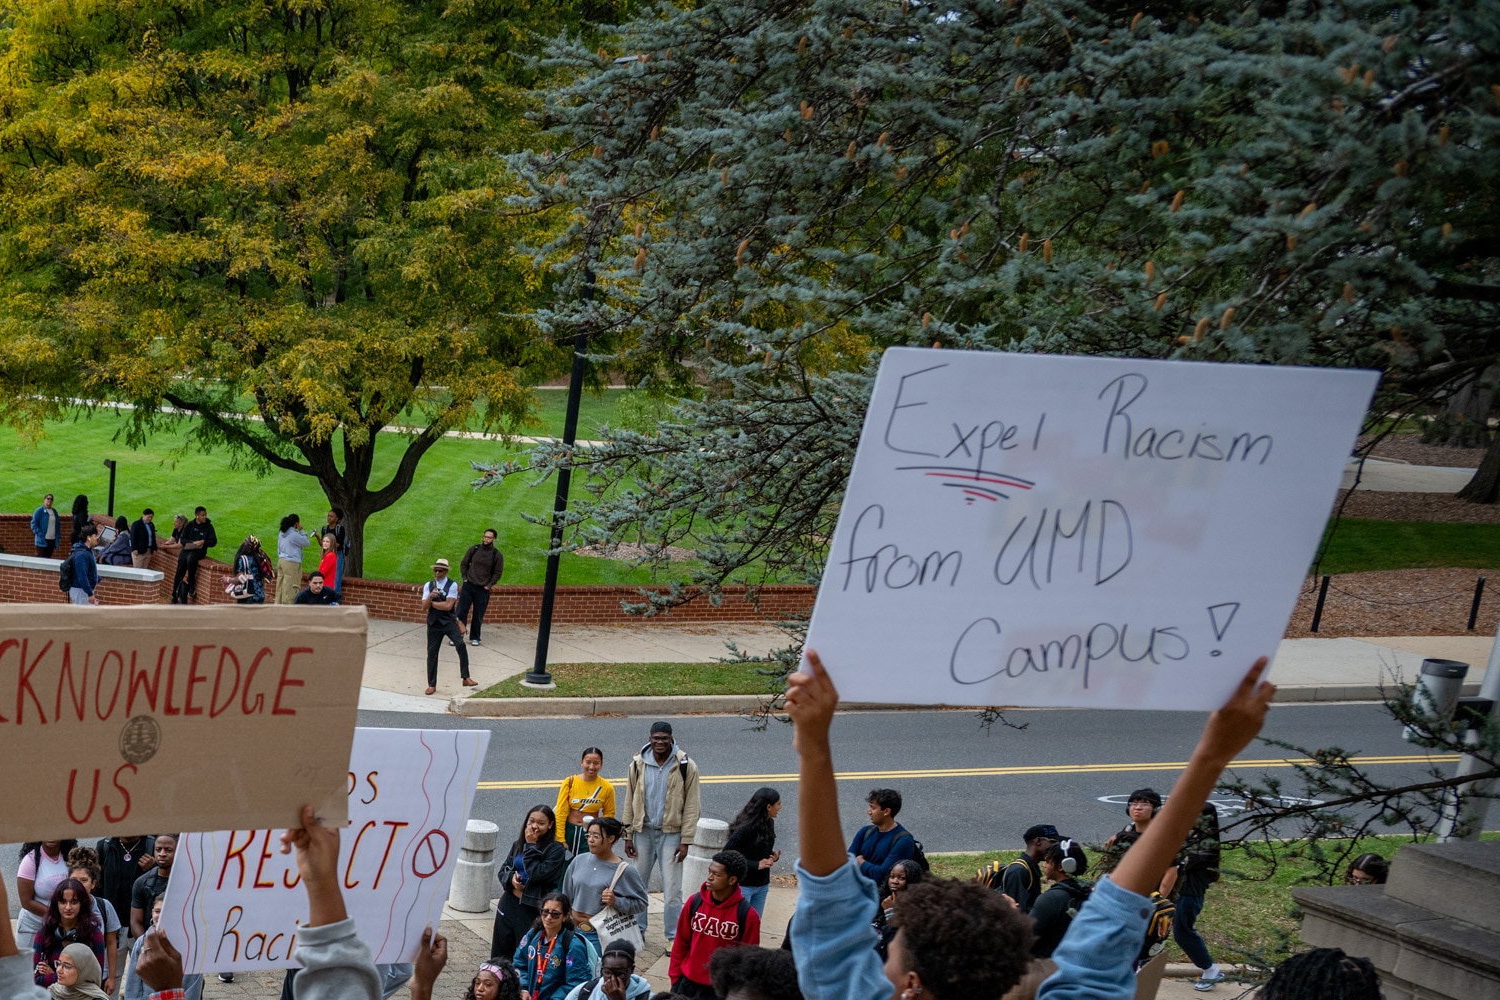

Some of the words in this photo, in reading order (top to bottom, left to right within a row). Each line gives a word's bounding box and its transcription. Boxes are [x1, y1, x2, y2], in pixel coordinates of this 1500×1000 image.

[884, 363, 1046, 480] Expel
[1098, 373, 1274, 466] Racism
[840, 503, 963, 593] from
[993, 499, 1133, 590] UMD
[949, 601, 1240, 689] Campus!
[66, 763, 138, 825] US
